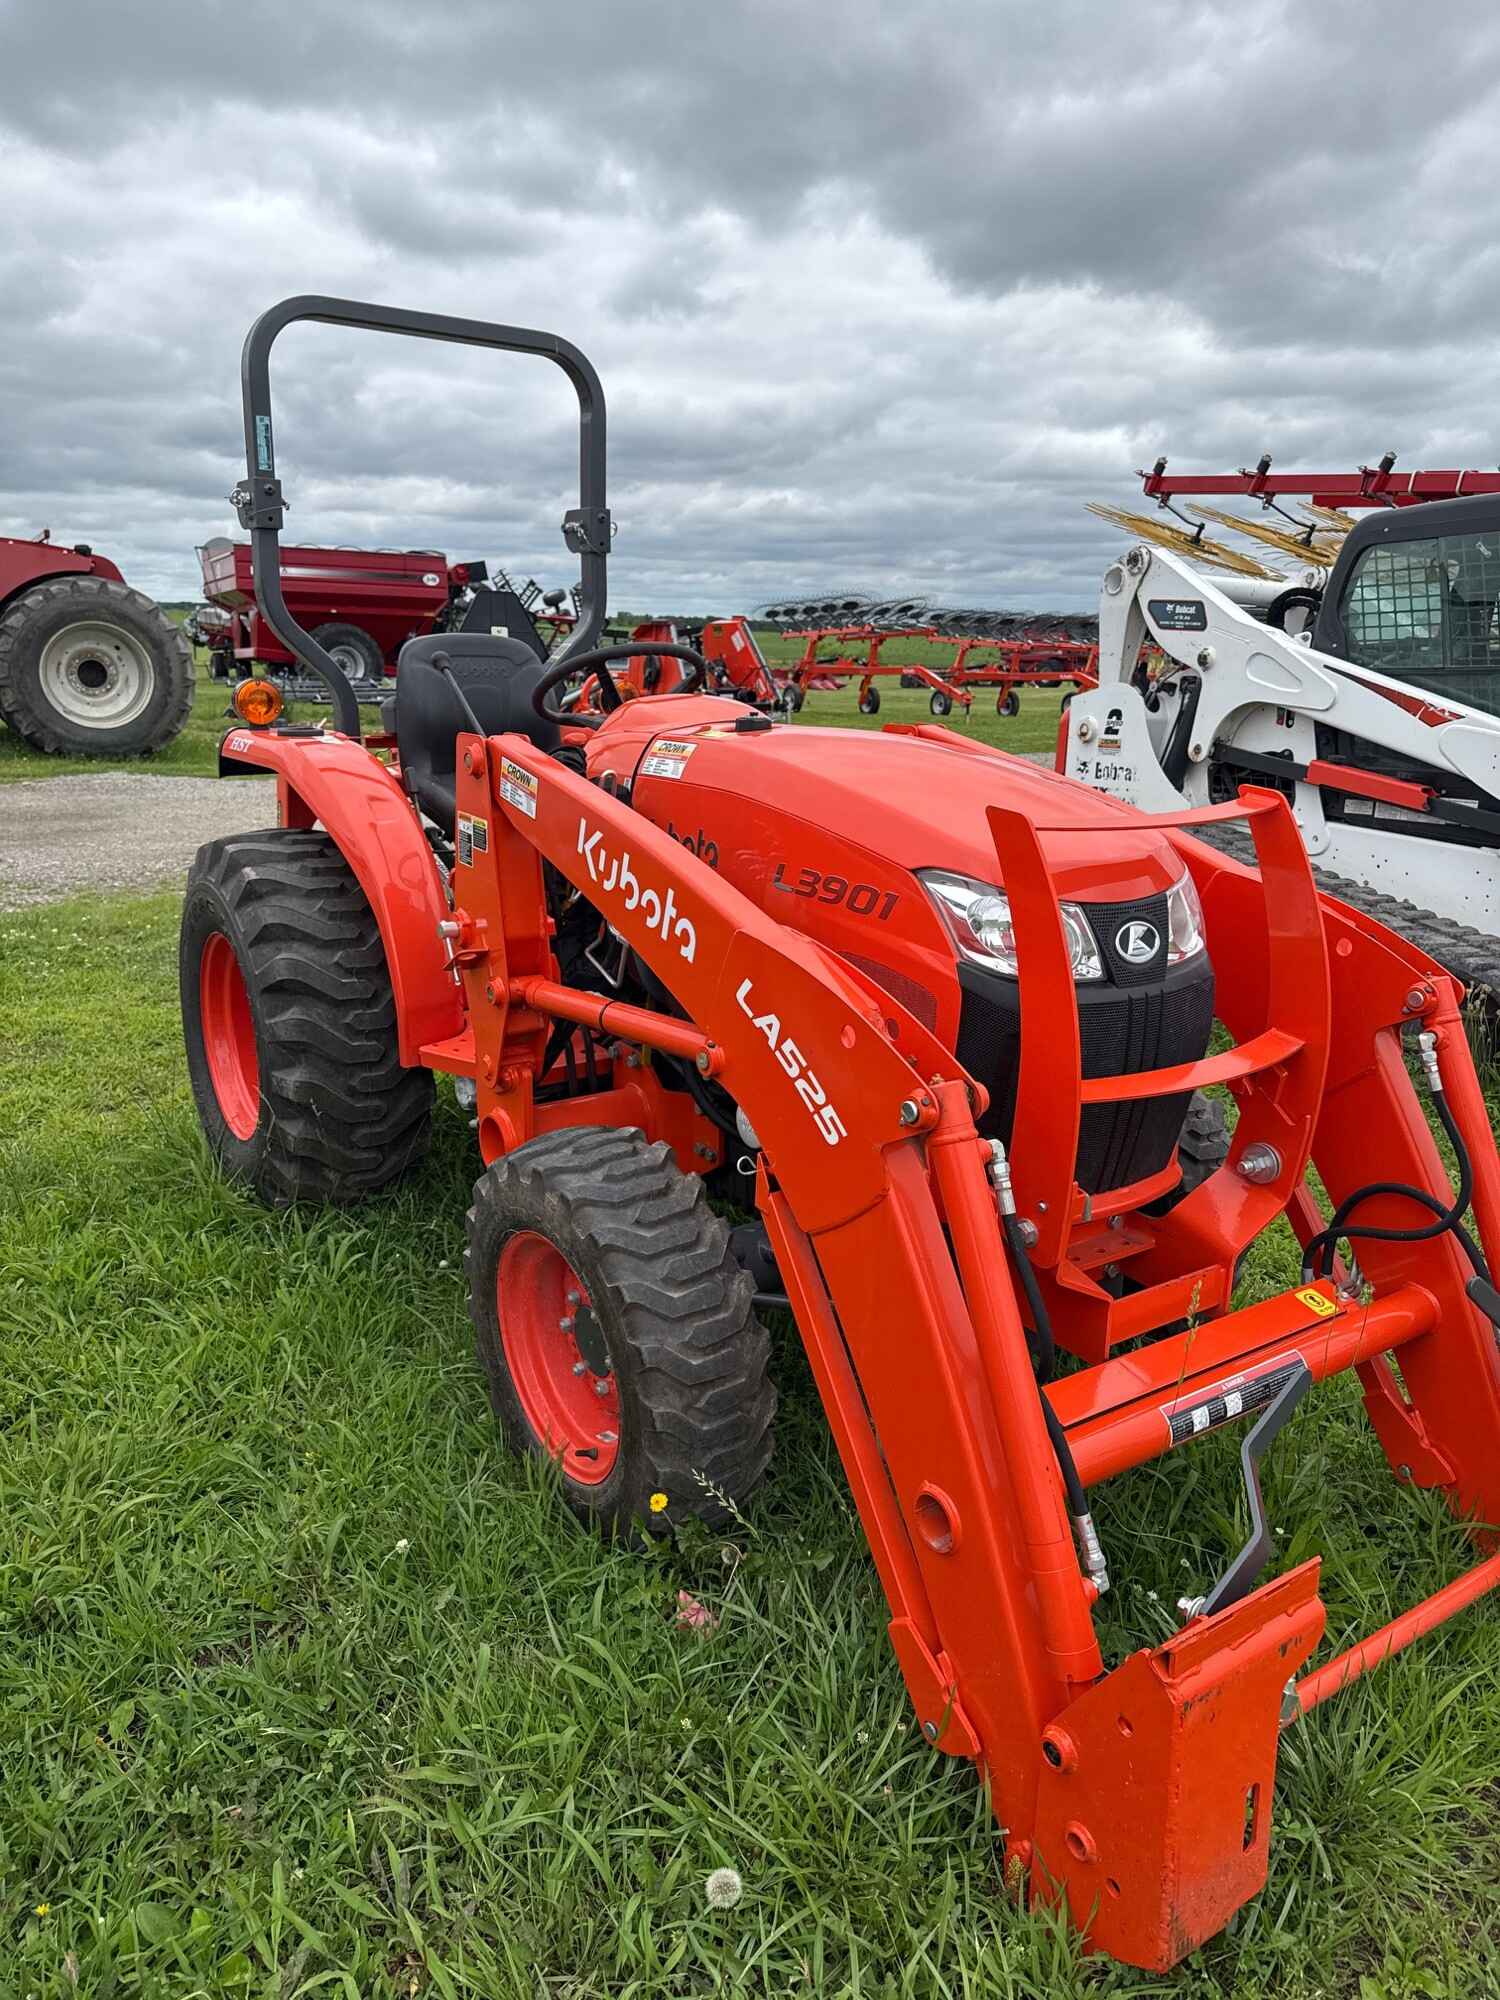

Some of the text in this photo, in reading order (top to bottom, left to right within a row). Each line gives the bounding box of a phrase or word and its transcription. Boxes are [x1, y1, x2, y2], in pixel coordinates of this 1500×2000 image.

[1104, 708, 1123, 735] 2
[230, 736, 255, 752] HST
[507, 763, 532, 788] CROWN
[577, 817, 697, 964] Kubota
[772, 863, 900, 921] L3901
[735, 977, 848, 1146] LA525
